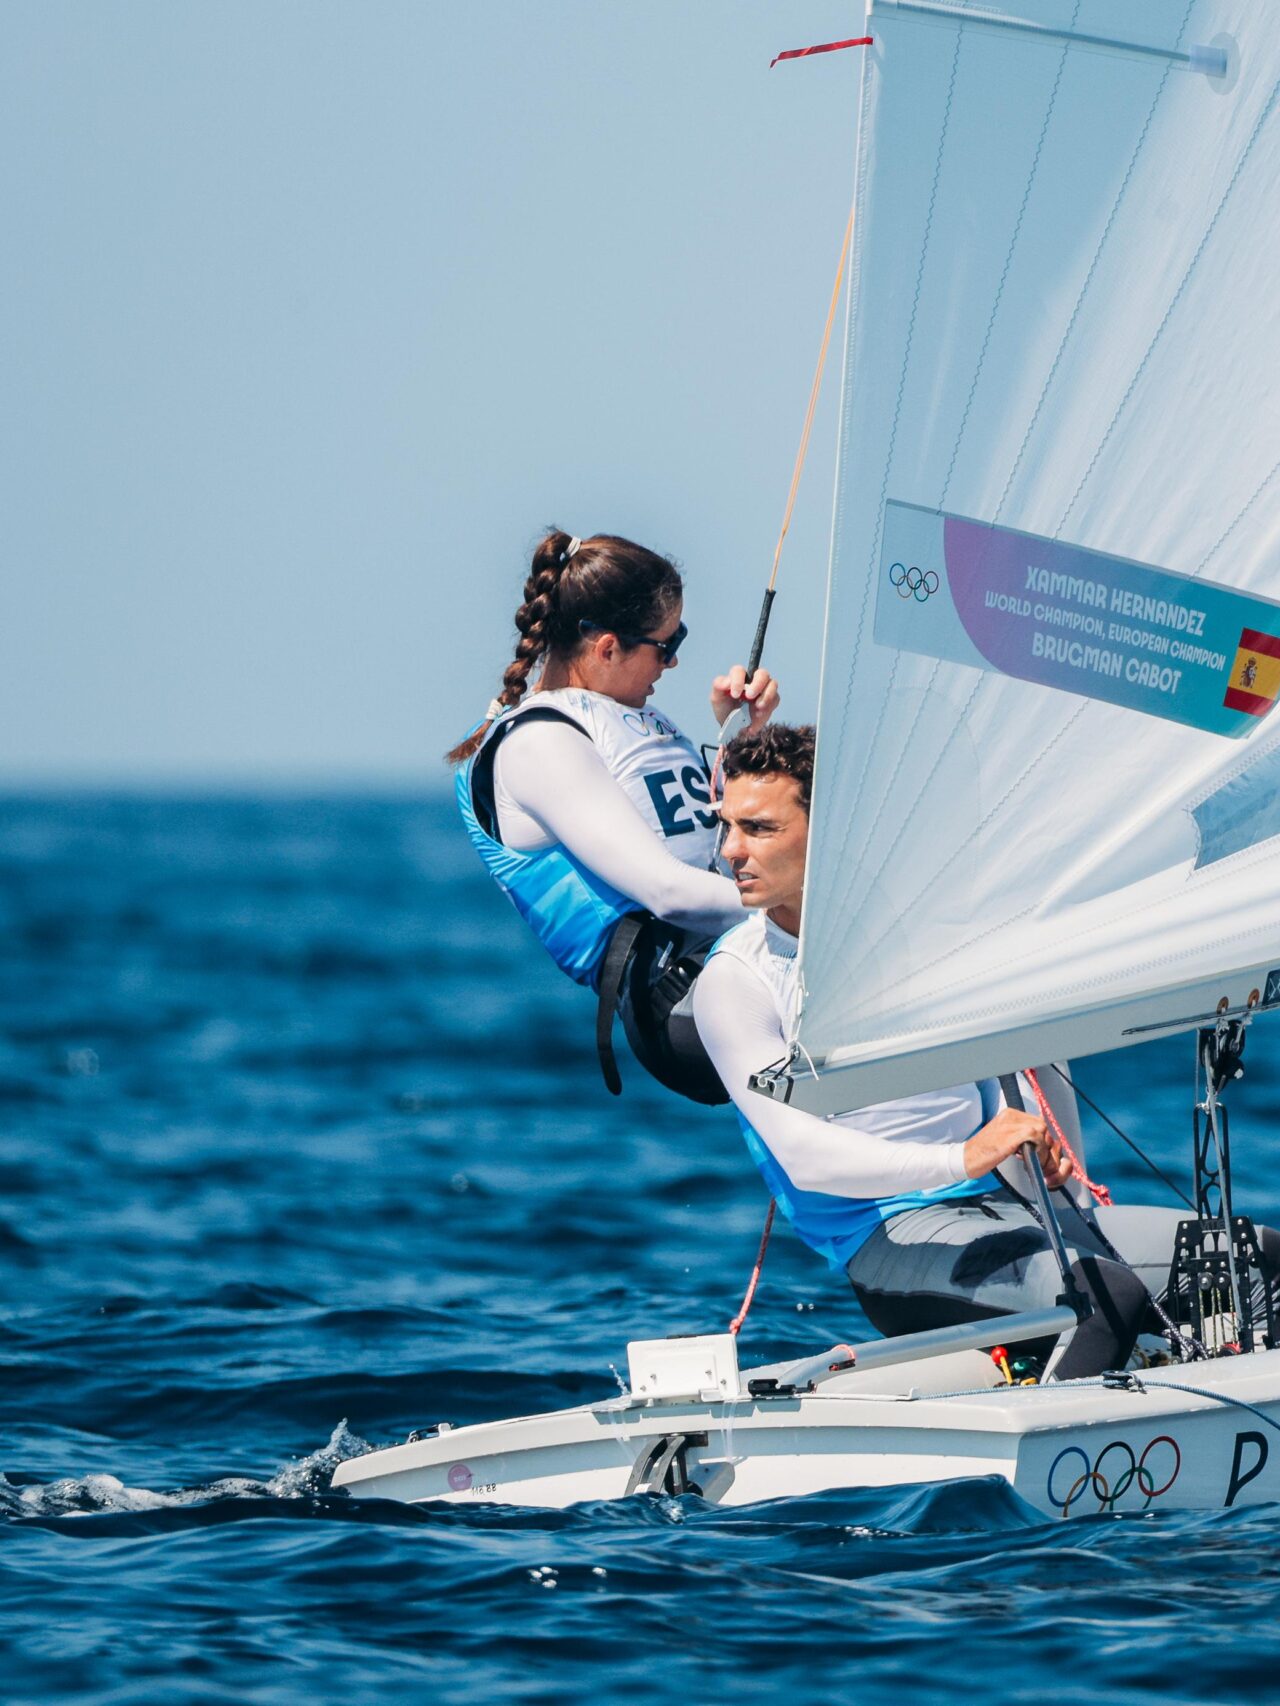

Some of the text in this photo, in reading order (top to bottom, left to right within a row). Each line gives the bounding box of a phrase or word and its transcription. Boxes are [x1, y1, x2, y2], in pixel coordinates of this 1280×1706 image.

[984, 590, 1226, 671] WORLD CHAMPION, EUROPEAN CHAMPION
[1025, 565, 1206, 637] XAMMAR HERNANDEZ
[1031, 631, 1182, 694] BRUGMAN CABOT
[643, 765, 719, 838] ES
